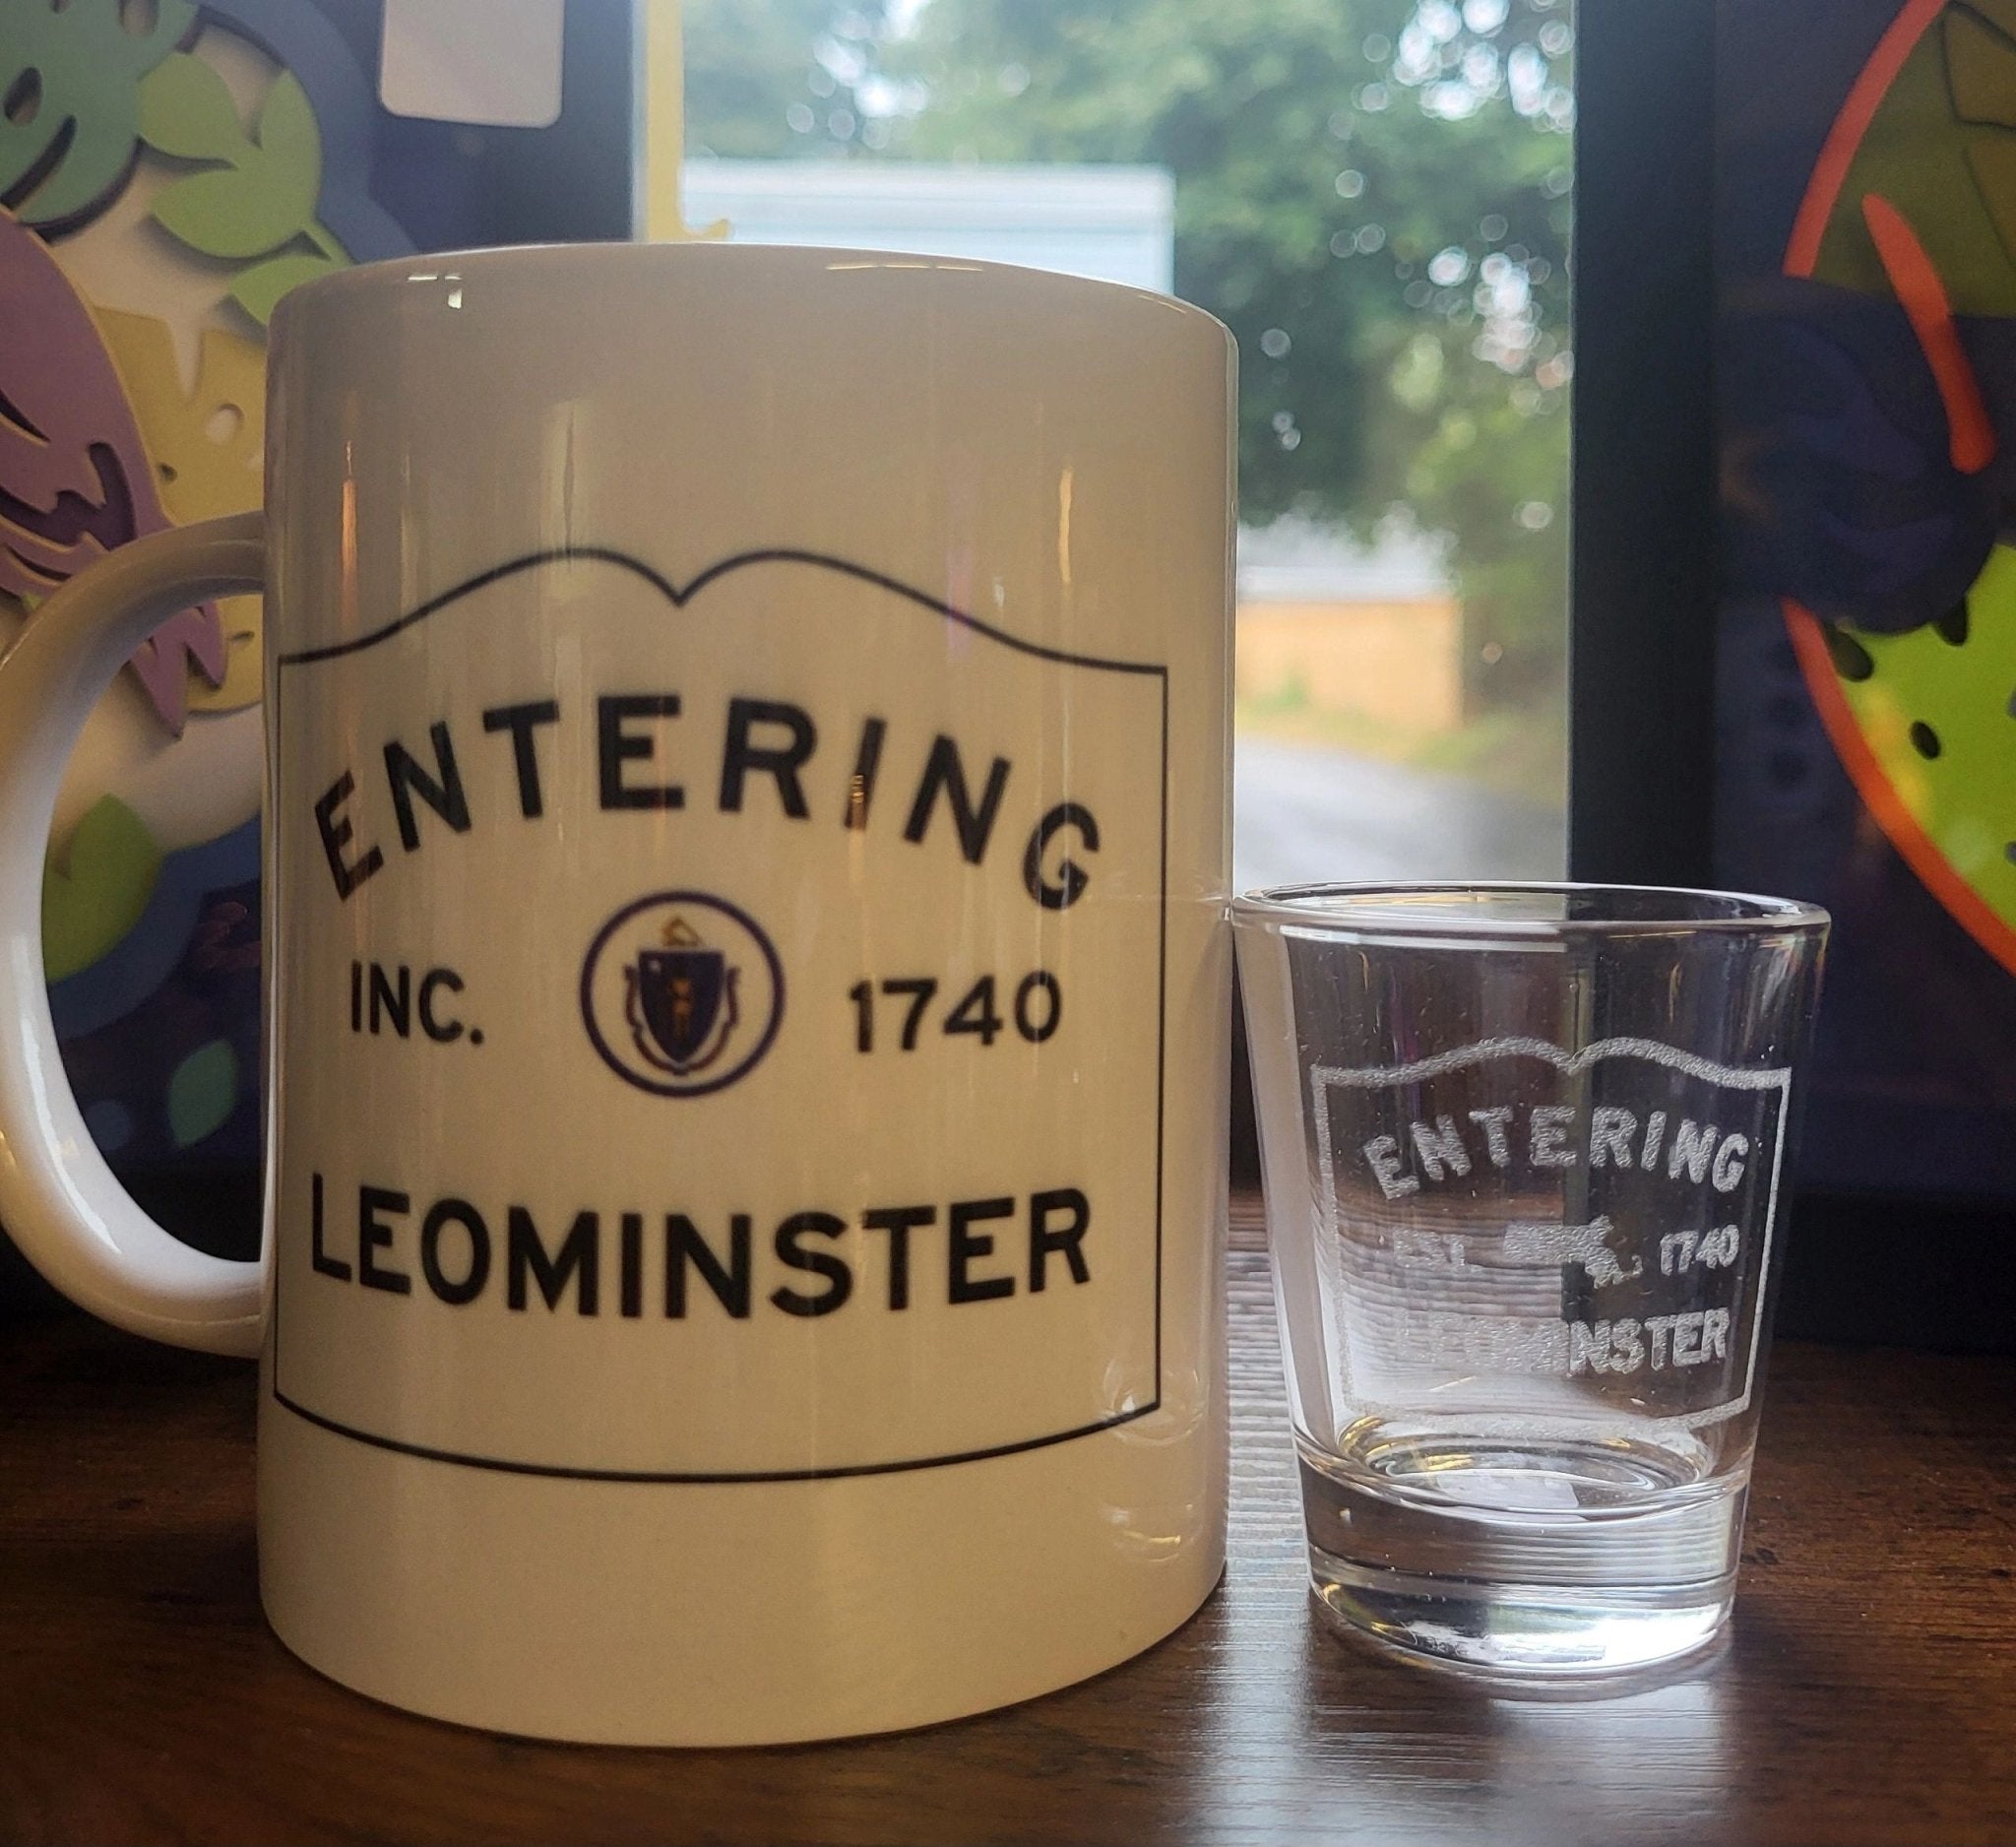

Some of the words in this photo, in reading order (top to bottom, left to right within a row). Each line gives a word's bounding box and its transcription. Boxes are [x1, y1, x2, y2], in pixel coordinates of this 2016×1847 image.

[315, 694, 1102, 911] ENTERING
[349, 958, 485, 1047] INC.
[848, 970, 1064, 1053] 1740
[1363, 1106, 1749, 1199] ENTERING
[311, 1172, 1092, 1320] LEOMINSTER
[1660, 1225, 1739, 1276] 1740
